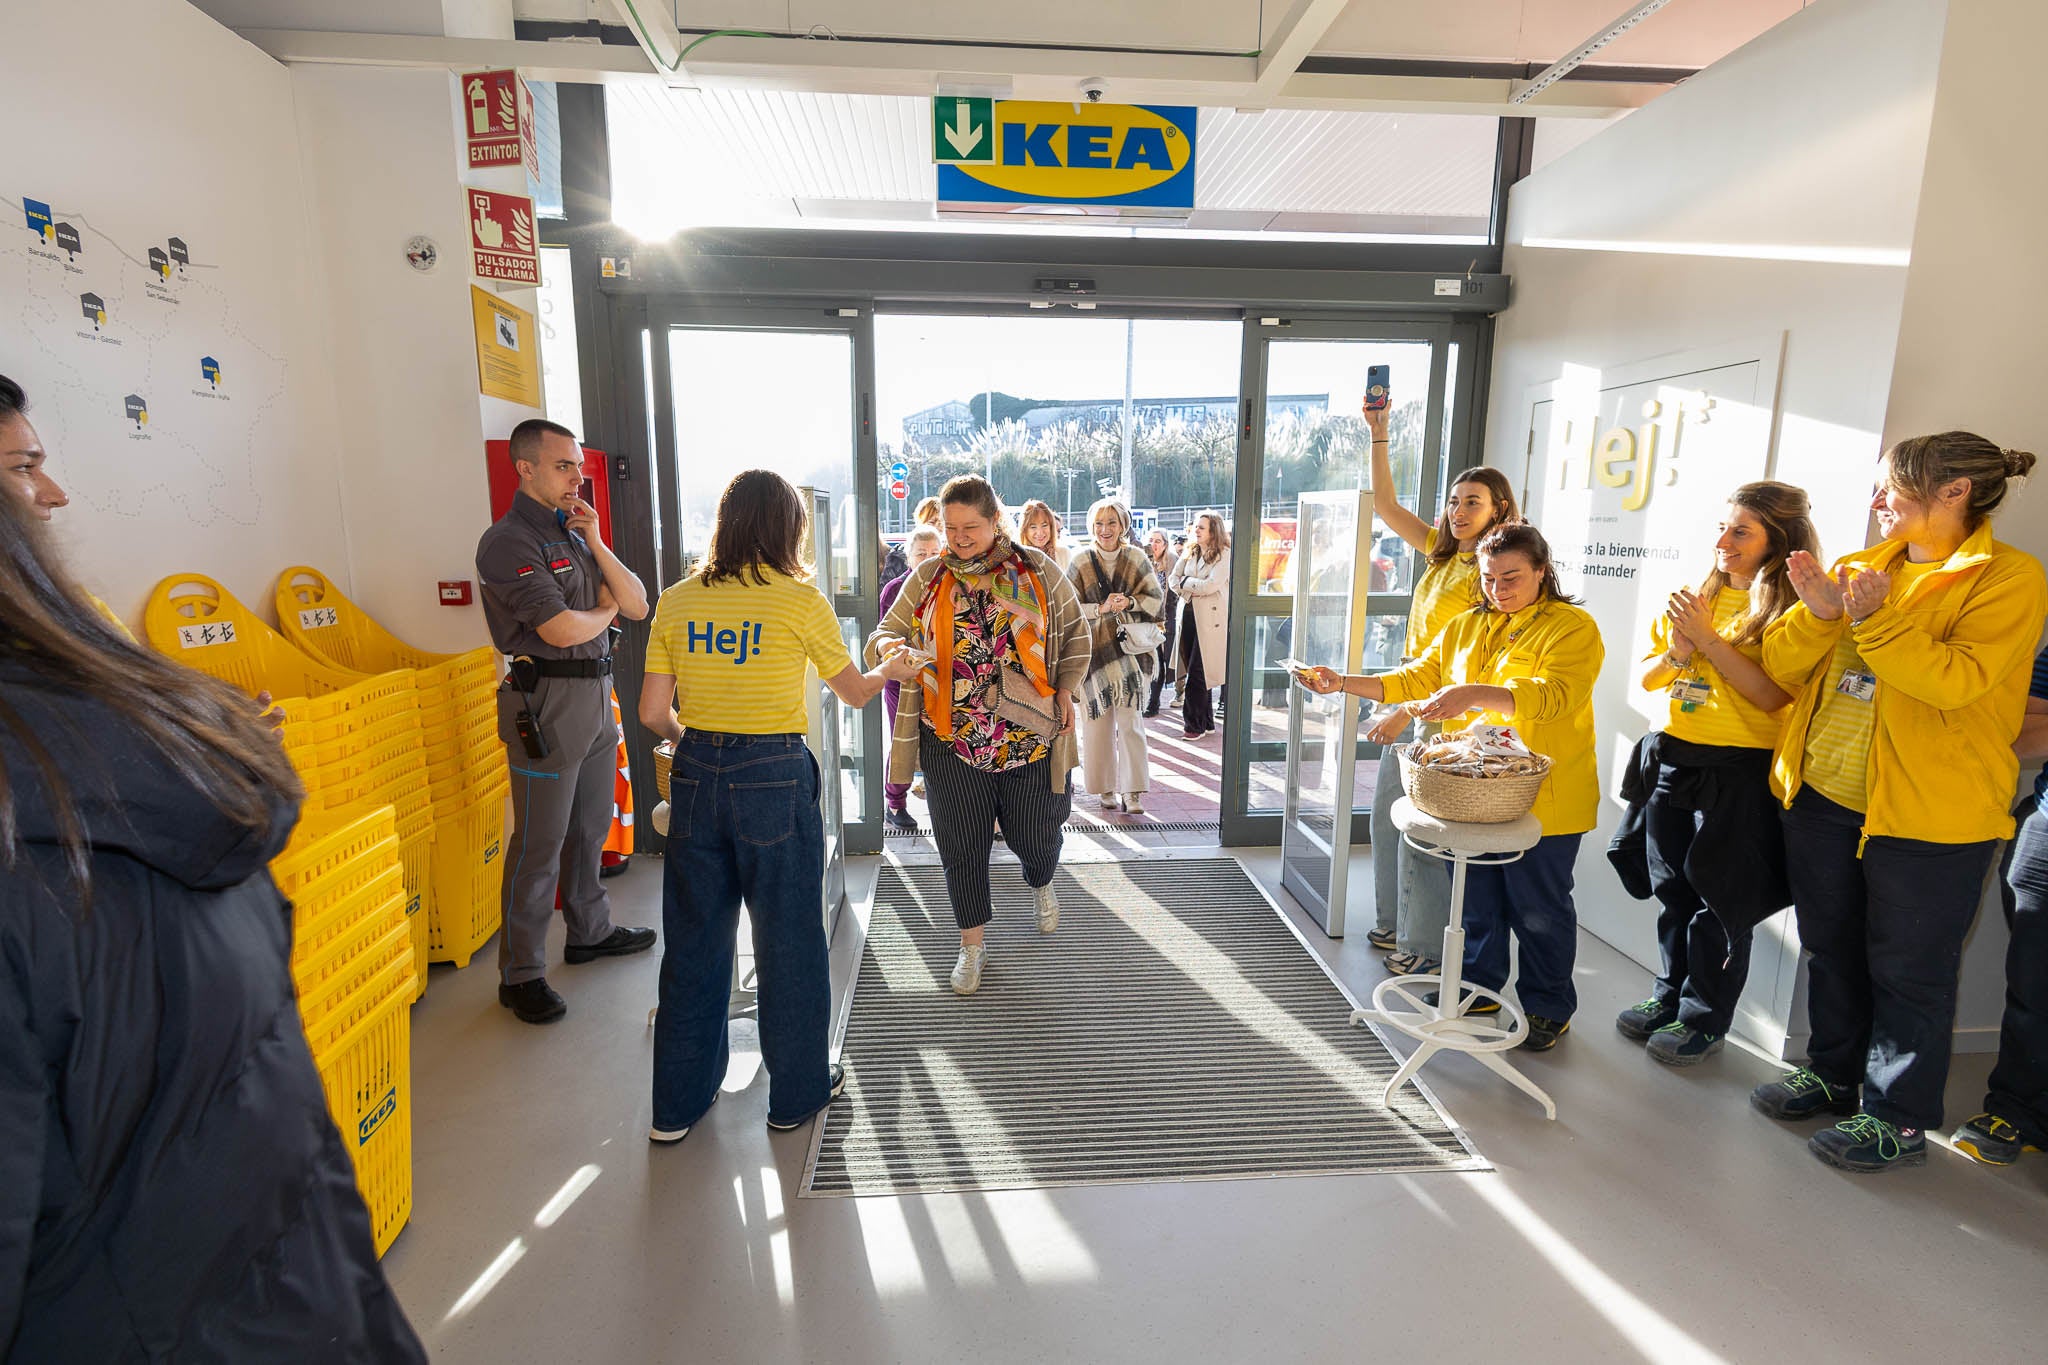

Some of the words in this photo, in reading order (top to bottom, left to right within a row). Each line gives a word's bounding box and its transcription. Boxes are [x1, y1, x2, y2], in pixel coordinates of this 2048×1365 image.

[471, 143, 519, 161] EXTINTOR
[1002, 123, 1174, 171] KEA
[58, 232, 78, 242] IKEA
[477, 254, 534, 270] PULSADOR
[478, 266, 492, 275] DE
[494, 268, 535, 281] ALARMA
[1464, 281, 1483, 294] 101
[1595, 541, 1606, 556] la
[1609, 542, 1680, 560] bienvenida
[1578, 563, 1637, 579] antander
[687, 620, 763, 665] Hej!
[364, 1097, 393, 1135] IKEA
